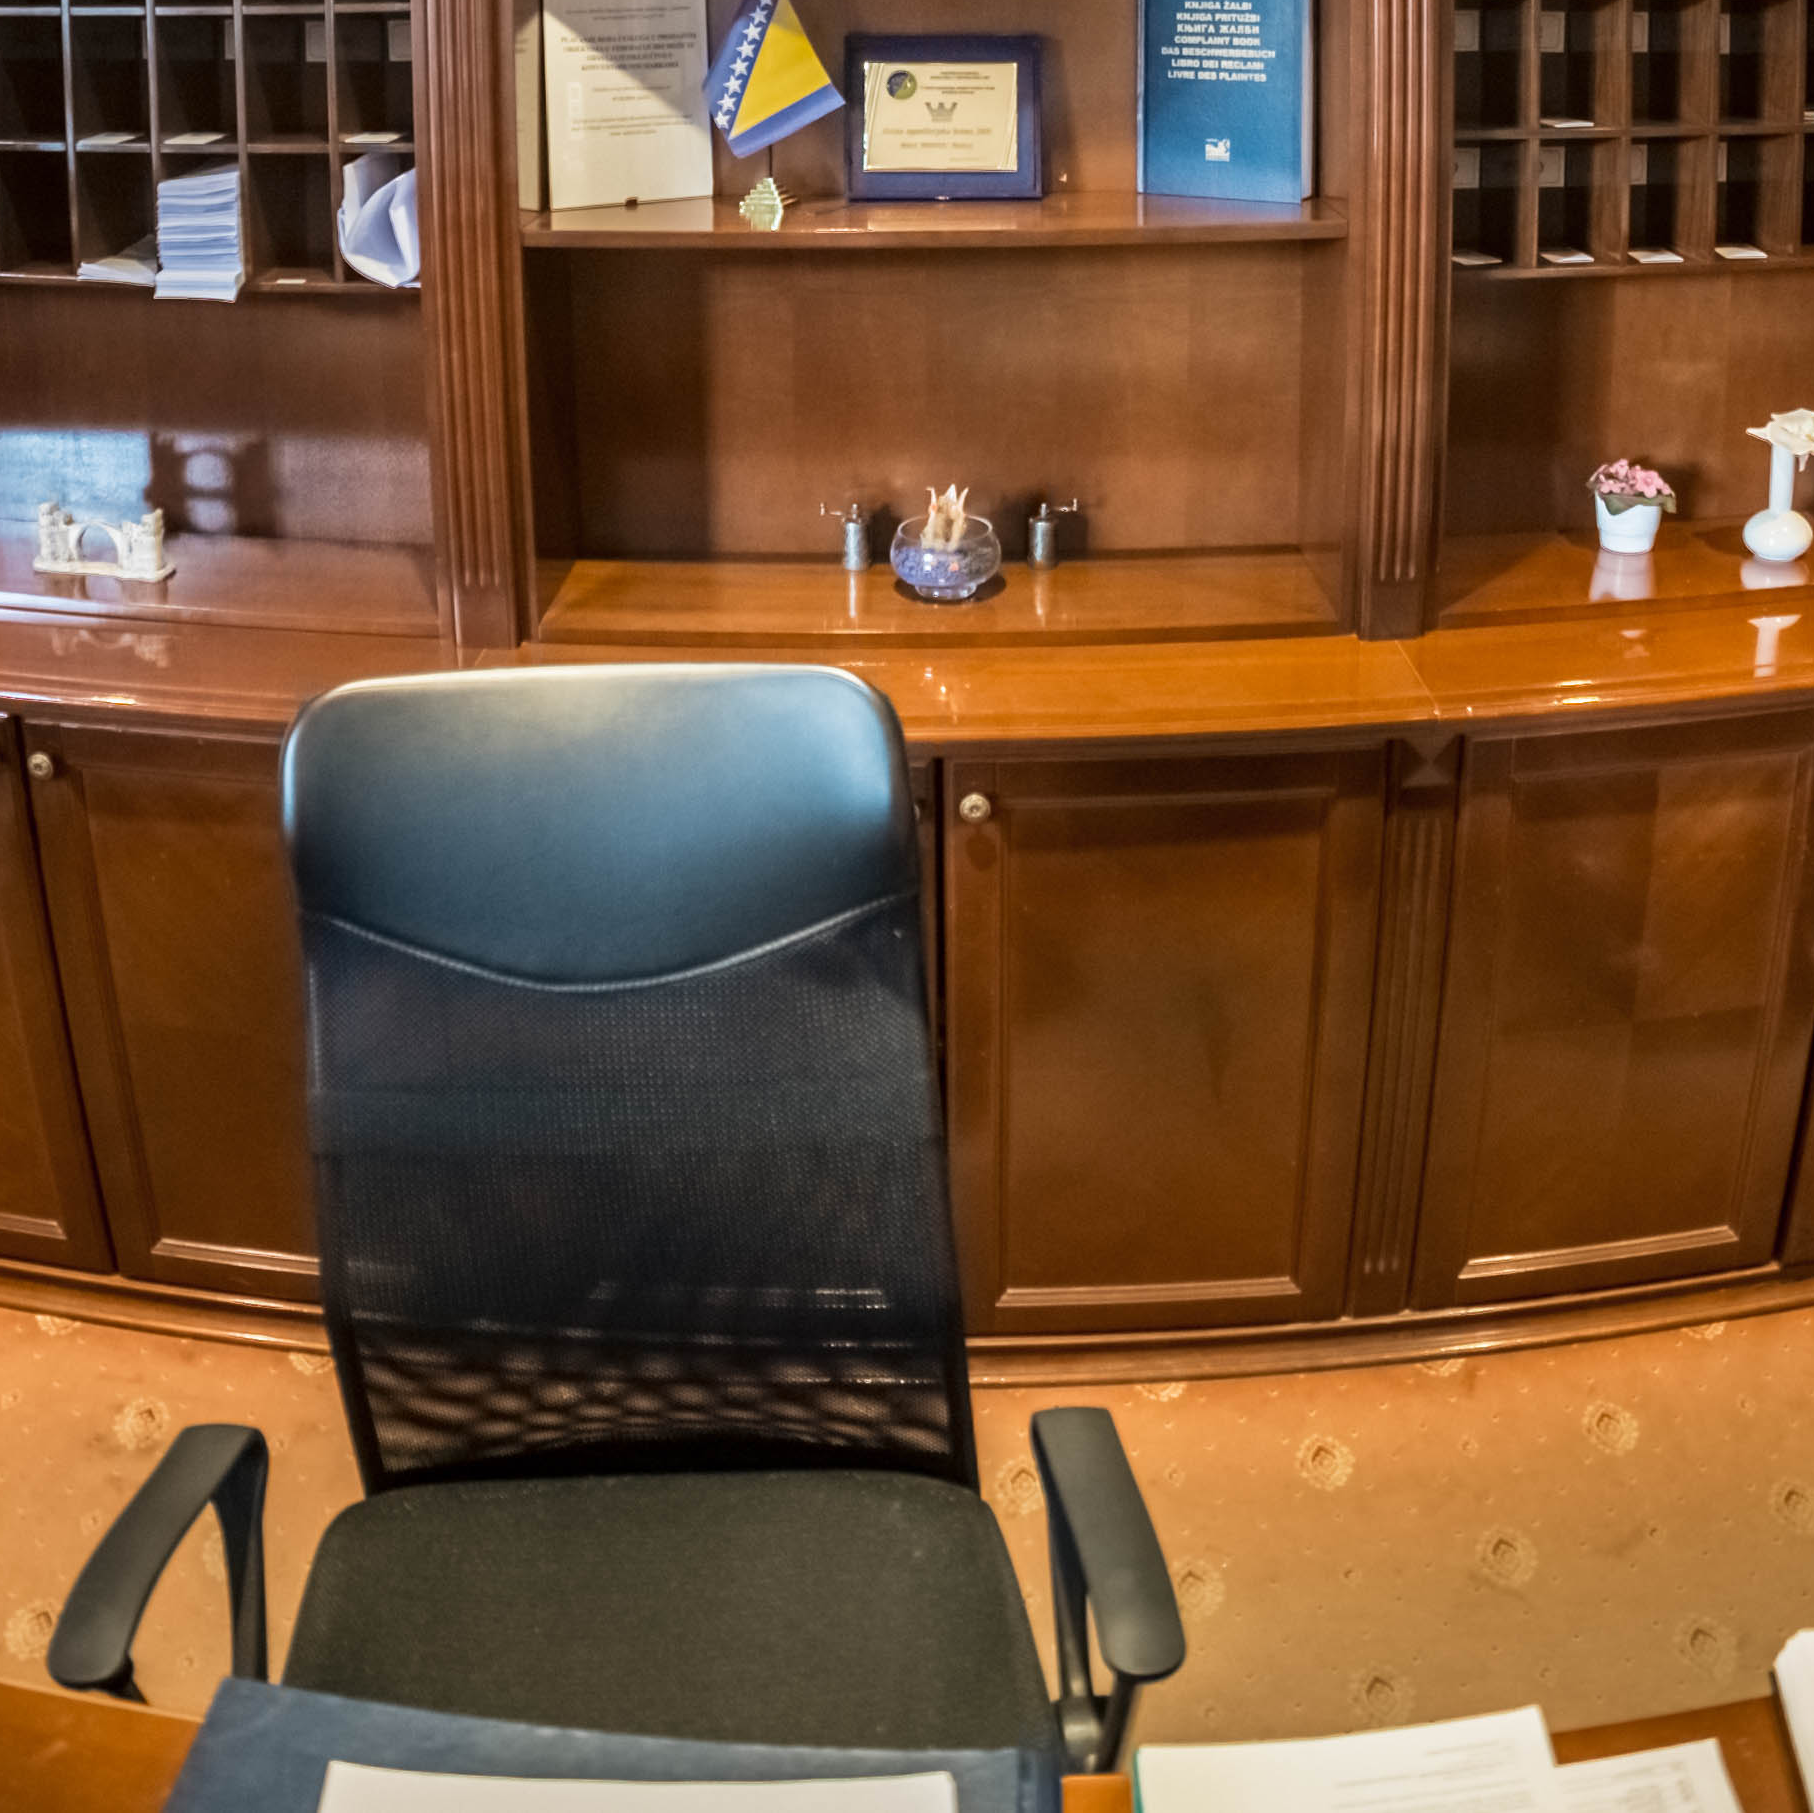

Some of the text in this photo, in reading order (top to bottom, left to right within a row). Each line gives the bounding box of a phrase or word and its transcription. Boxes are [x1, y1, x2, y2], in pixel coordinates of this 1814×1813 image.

[1184, 0, 1252, 11] KNJIGA ŽALBI
[1176, 12, 1260, 23] KNJIGA PRITUŽBI
[1176, 23, 1216, 34] КЊИГА
[1174, 35, 1261, 47] COMPLAINT BOOK
[1161, 46, 1180, 56] DAS
[1171, 58, 1265, 71] LIBRO DEI RECLAMI
[1167, 69, 1267, 83] LIVRE DES PLAINTES
